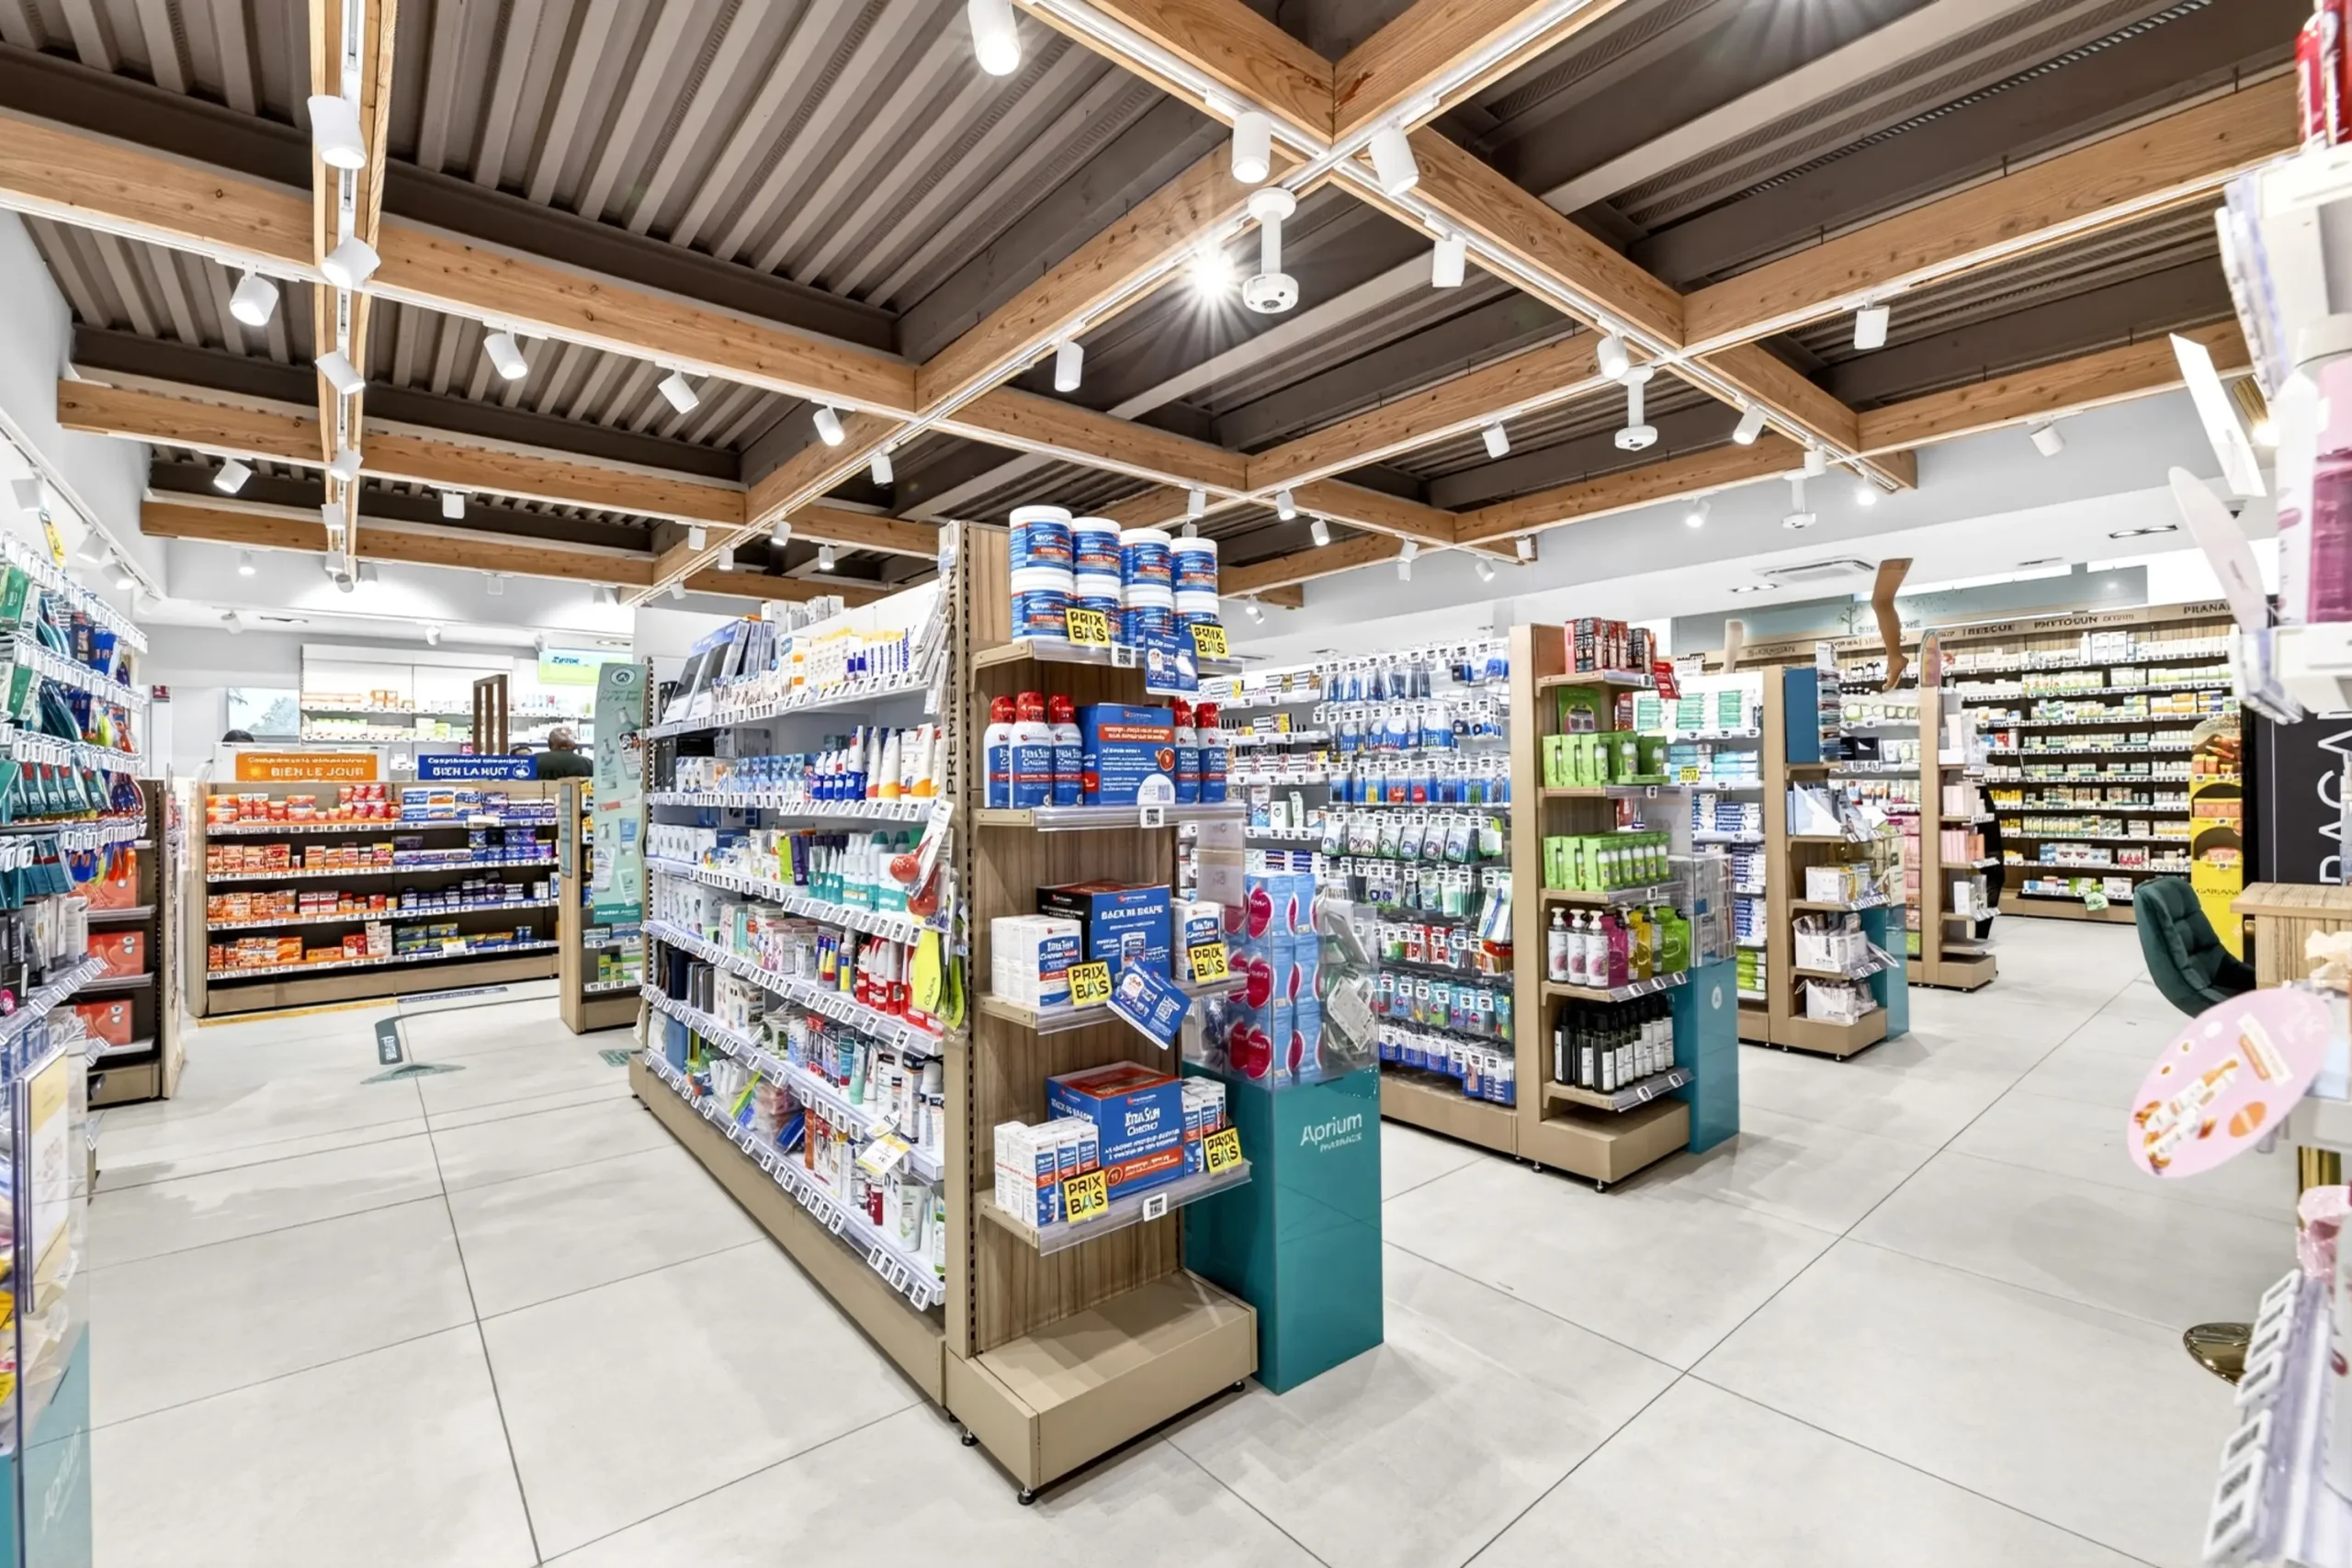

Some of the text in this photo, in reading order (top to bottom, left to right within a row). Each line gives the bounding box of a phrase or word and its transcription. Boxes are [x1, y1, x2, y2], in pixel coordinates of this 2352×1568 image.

[307, 767, 323, 776] LE
[326, 766, 365, 776] JOUR
[463, 767, 479, 776] LA
[1072, 964, 1107, 981] PRIX
[1075, 980, 1110, 999] BAS
[1299, 1112, 1363, 1147] Aprium
[1068, 1175, 1102, 1197] PRIX
[1070, 1190, 1105, 1215] BAS
